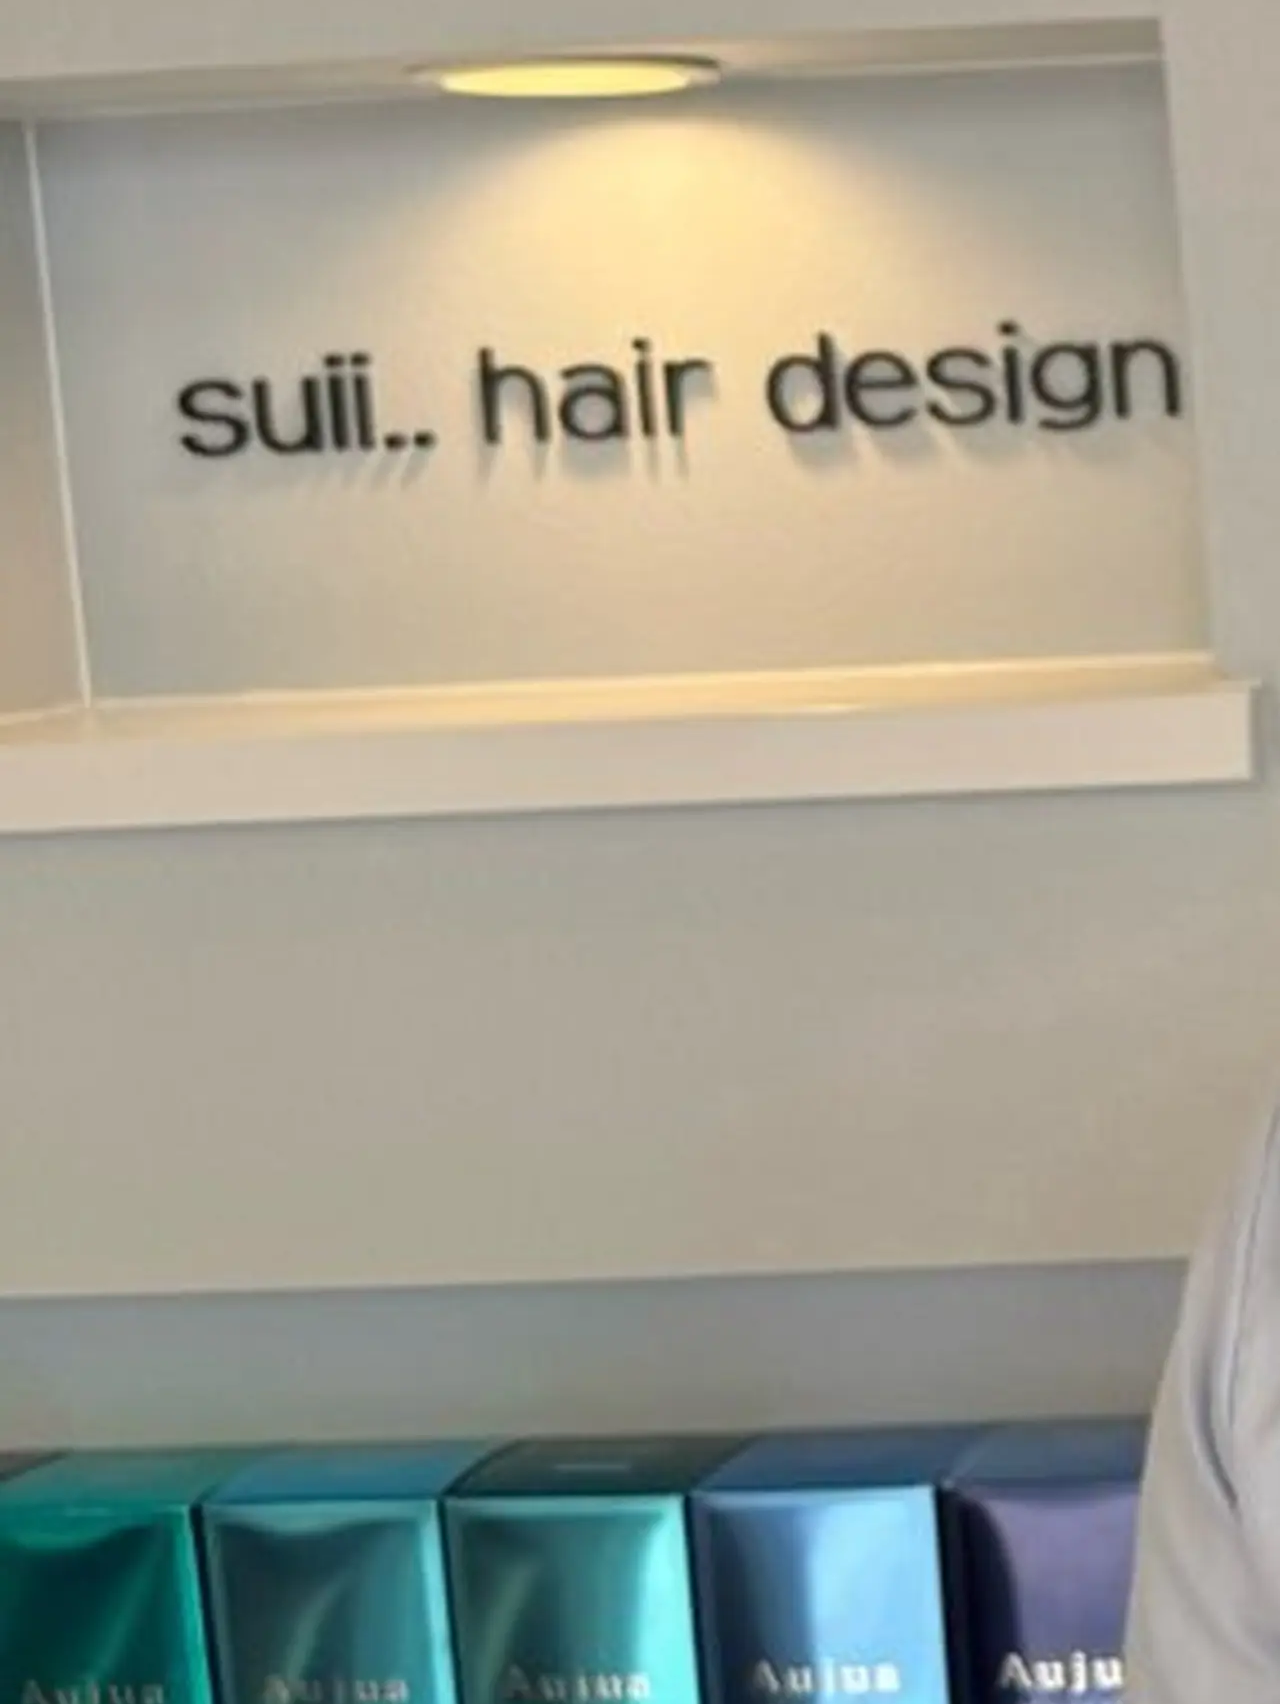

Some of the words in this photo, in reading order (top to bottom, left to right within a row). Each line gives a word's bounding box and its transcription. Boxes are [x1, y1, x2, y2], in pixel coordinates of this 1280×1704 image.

[176, 352, 436, 458] suii..
[478, 337, 712, 446] hair
[765, 321, 1182, 433] design
[753, 1658, 902, 1697] Aujua
